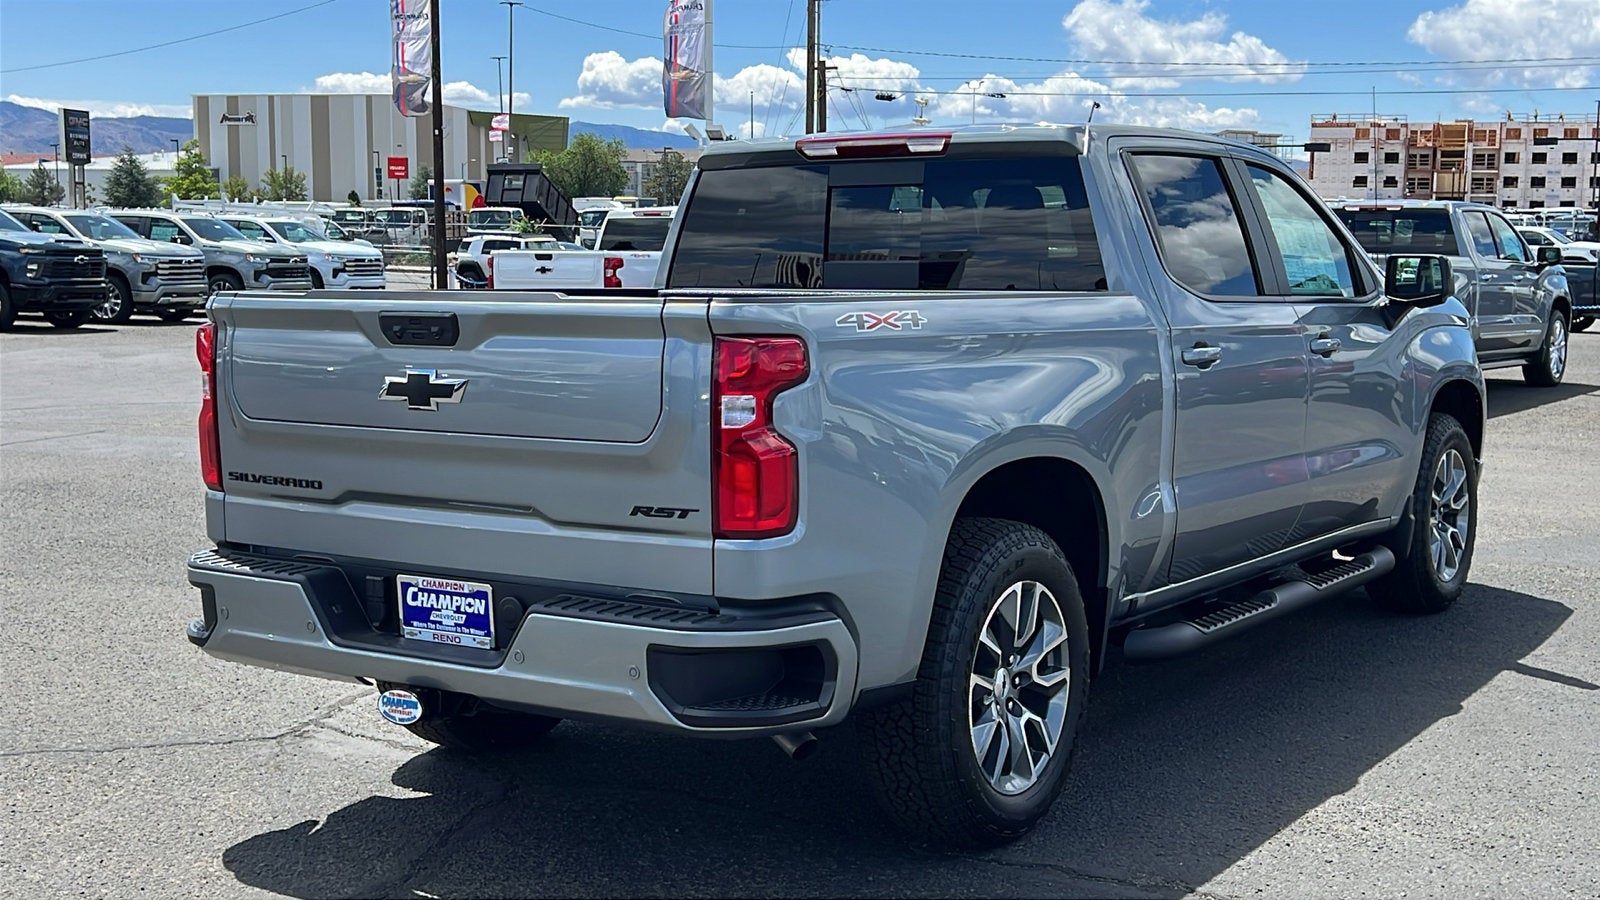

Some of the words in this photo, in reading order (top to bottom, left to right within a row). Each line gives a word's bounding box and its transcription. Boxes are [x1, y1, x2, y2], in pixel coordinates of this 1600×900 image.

[228, 471, 323, 490] SILVERADO
[629, 505, 700, 519] RST
[421, 579, 465, 592] CHAMPION
[406, 586, 486, 615] CHAMPION
[432, 612, 464, 621] CHEVROLET
[427, 622, 436, 630] The
[462, 626, 470, 634] The
[432, 633, 462, 644] RENO
[382, 695, 419, 710] CHAMPION
